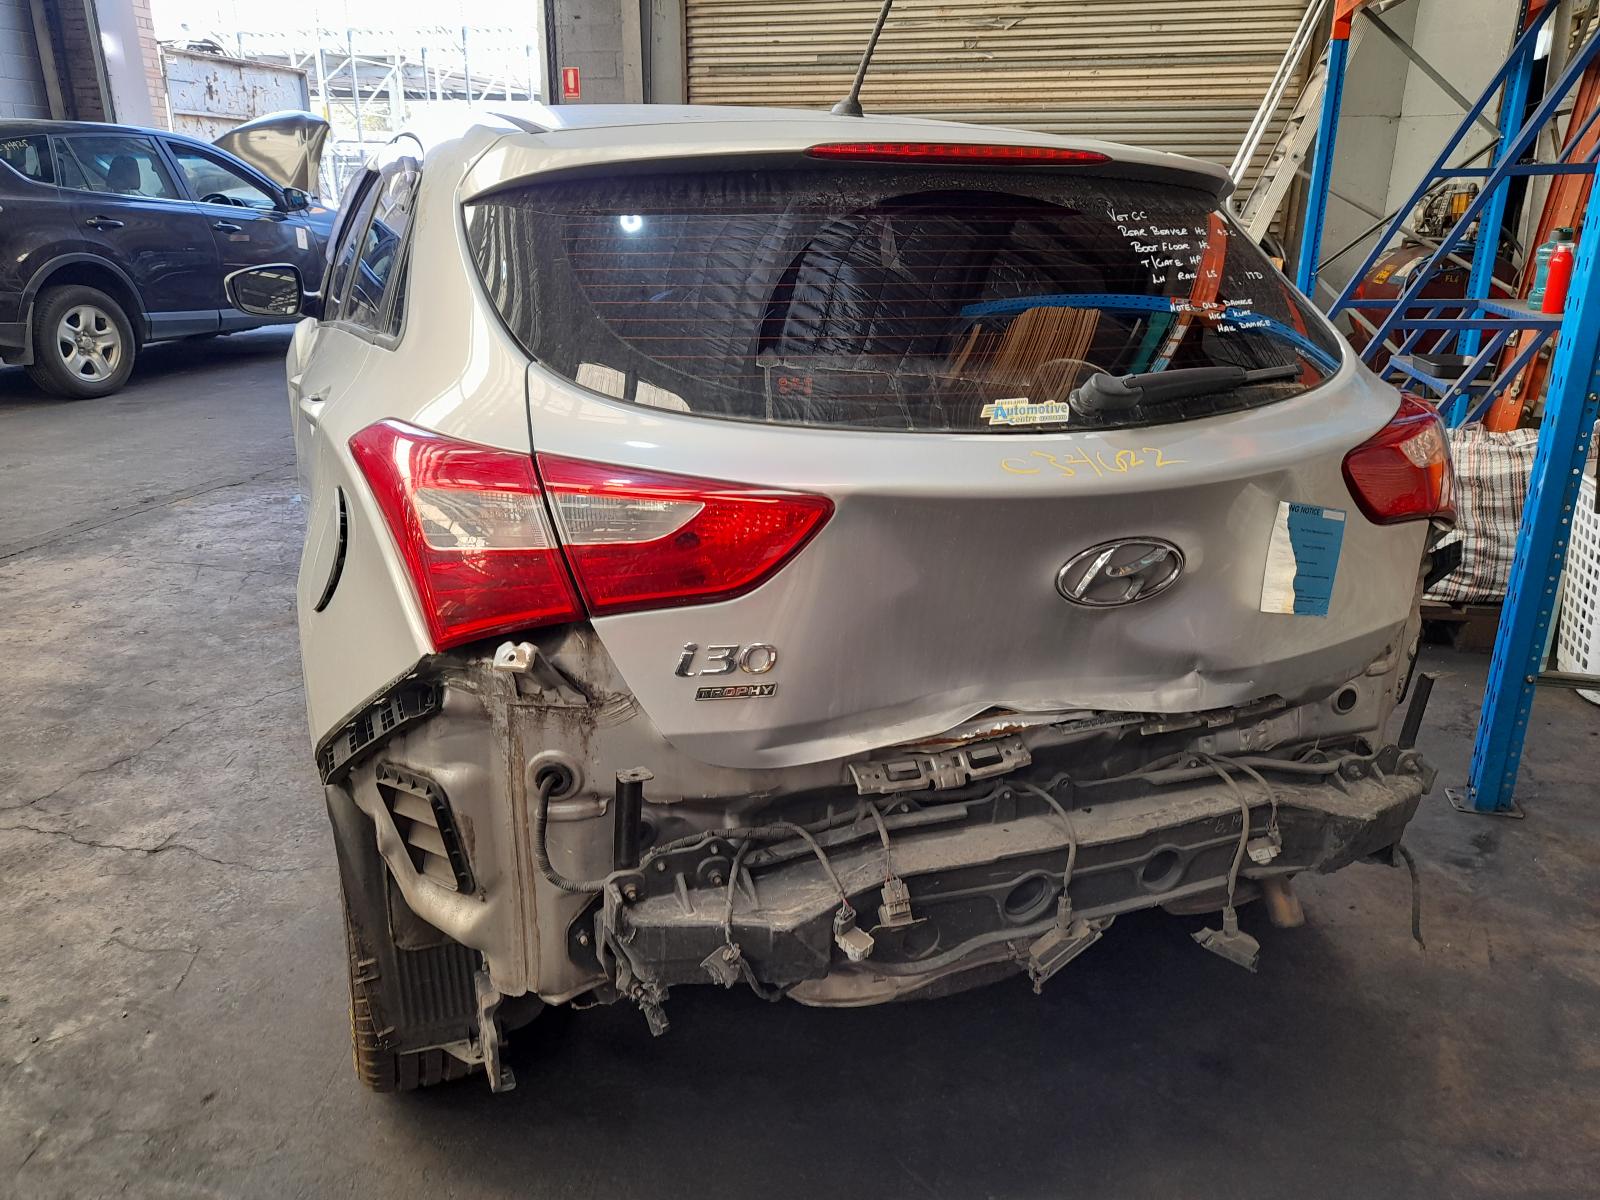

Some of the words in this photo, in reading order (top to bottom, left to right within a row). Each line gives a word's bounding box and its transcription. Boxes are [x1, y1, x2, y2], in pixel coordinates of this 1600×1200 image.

[1130, 241, 1159, 253] BOOT
[1162, 242, 1190, 252] FLOOR
[1202, 302, 1219, 310] OLD
[1217, 323, 1237, 333] HAIL
[1238, 319, 1272, 329] DAMAGE
[993, 403, 1067, 419] Automotive
[675, 641, 778, 678] i30
[699, 684, 775, 698] TROPHY
